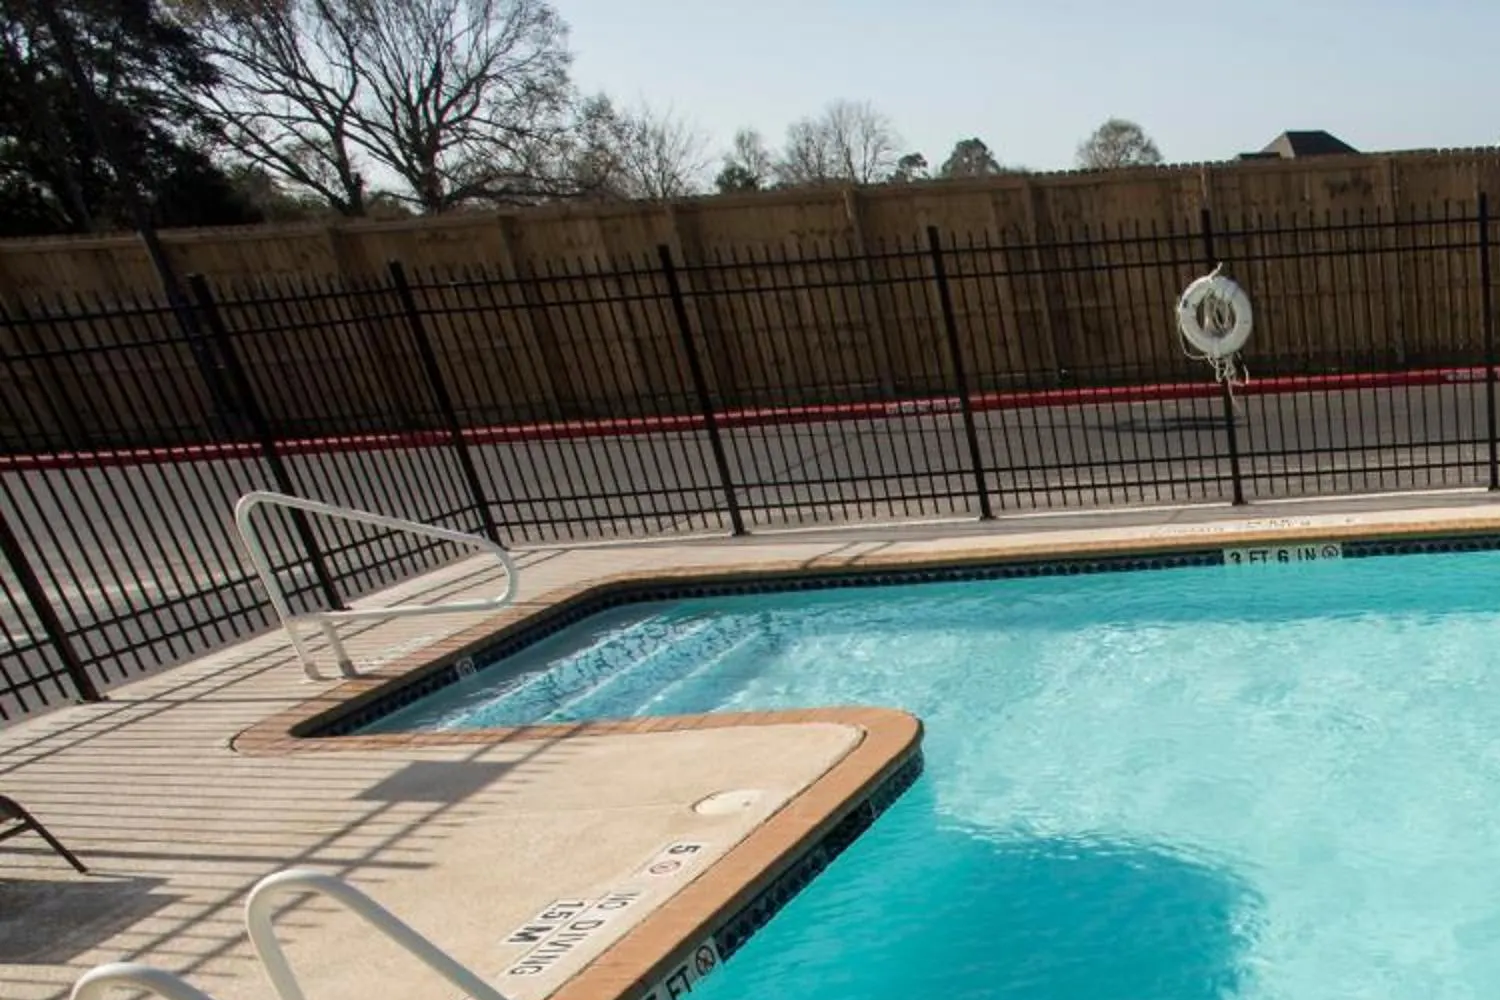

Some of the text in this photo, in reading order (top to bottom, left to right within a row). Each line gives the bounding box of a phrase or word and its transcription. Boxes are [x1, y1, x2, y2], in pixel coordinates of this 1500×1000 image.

[1249, 549, 1268, 564] FT
[1277, 549, 1289, 563] 6
[1297, 547, 1317, 561] IN
[508, 926, 552, 942] M
[509, 892, 641, 975] NO DIVING
